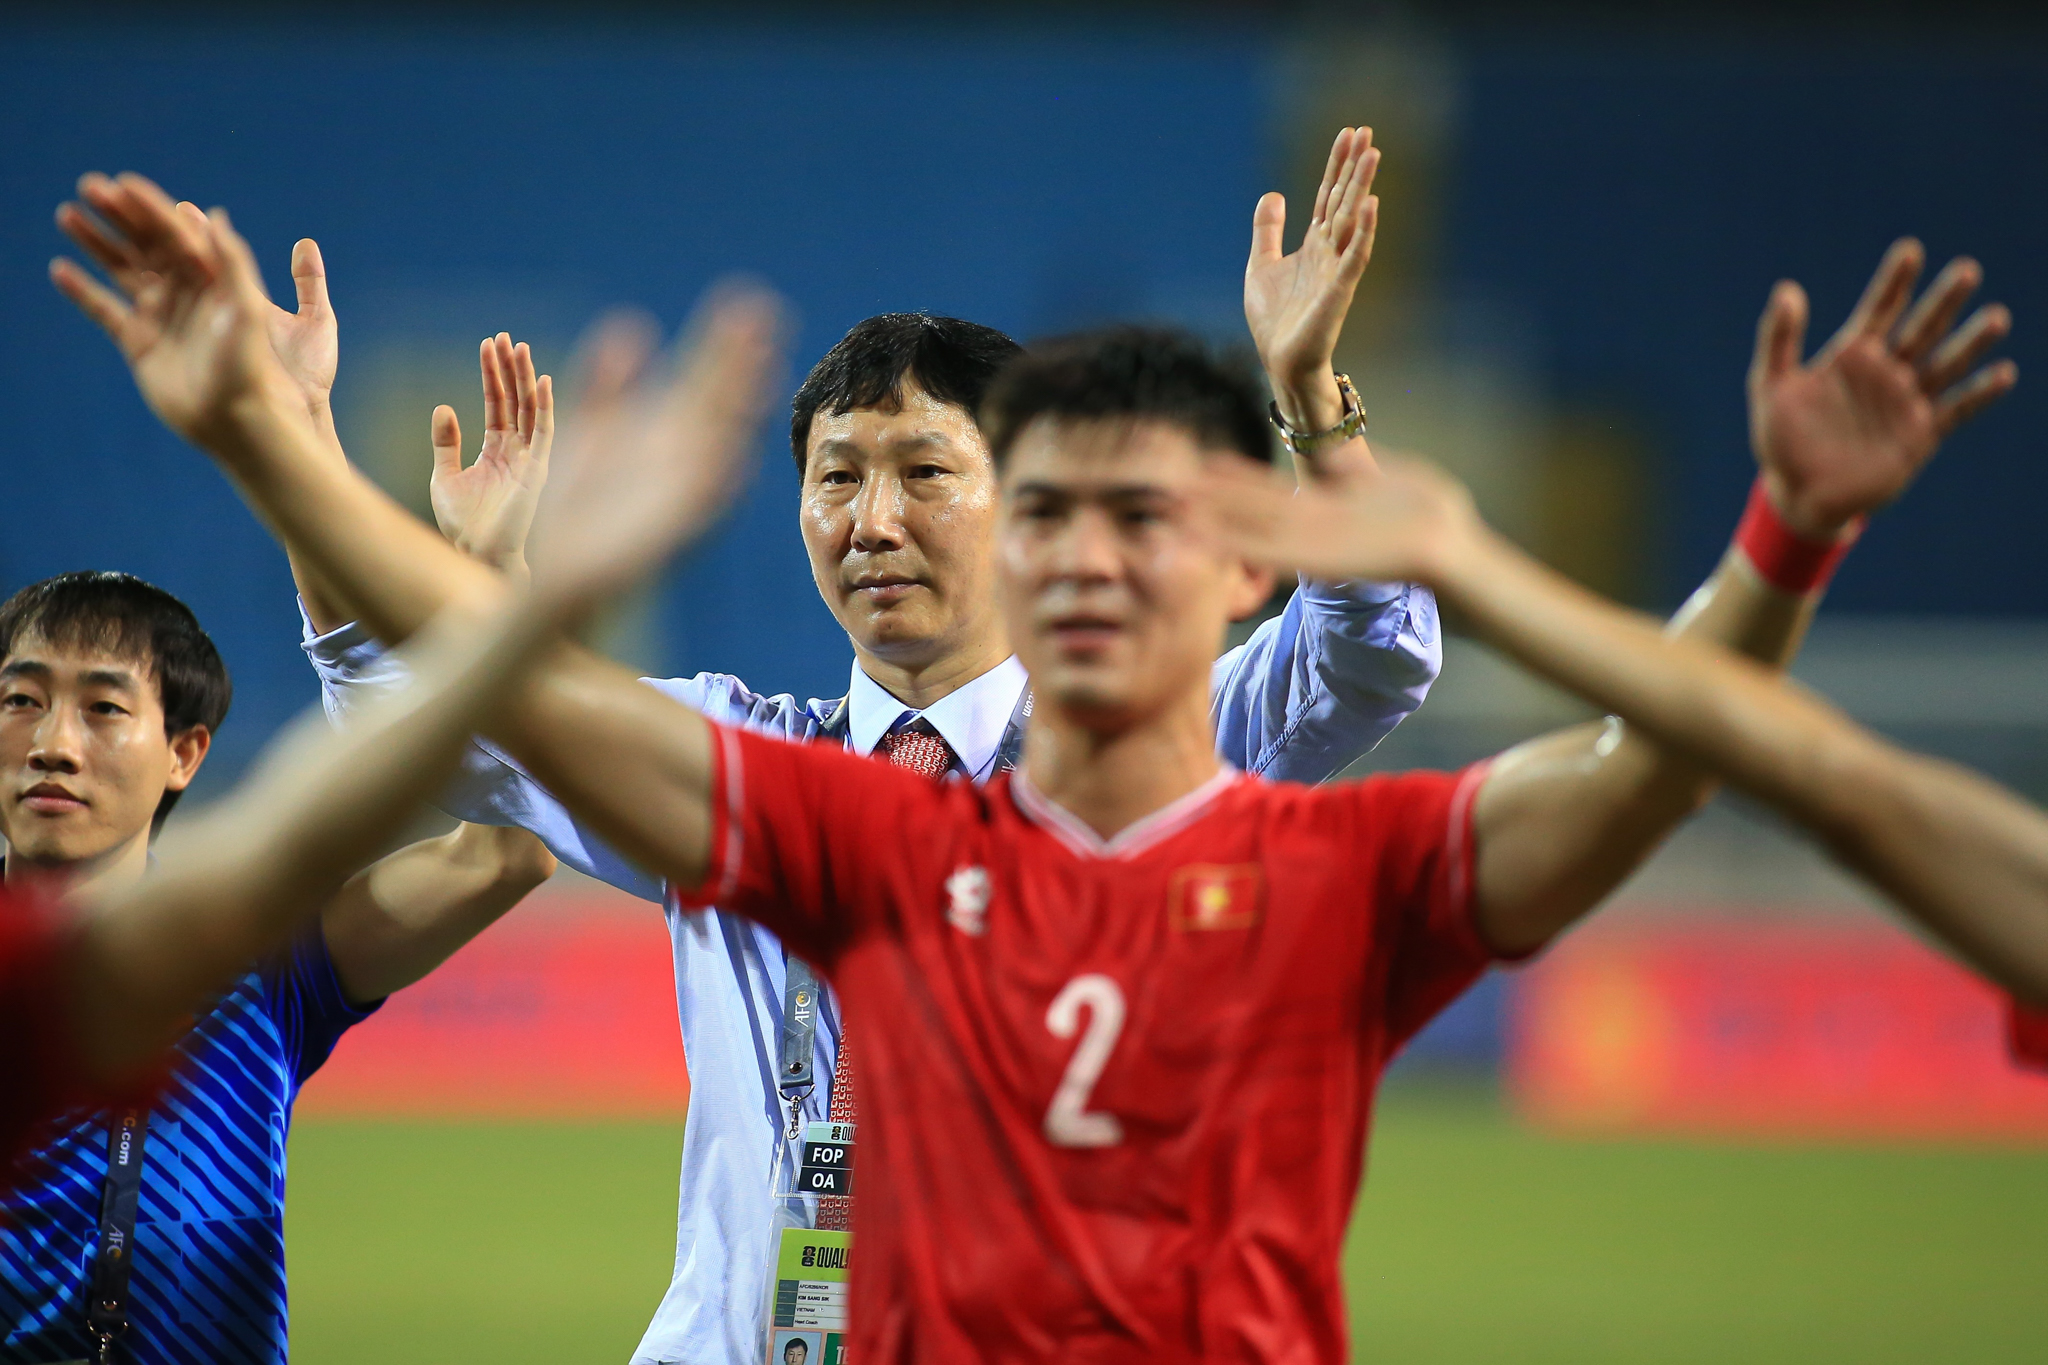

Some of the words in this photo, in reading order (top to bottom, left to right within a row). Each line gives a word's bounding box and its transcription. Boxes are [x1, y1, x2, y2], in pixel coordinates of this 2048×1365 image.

[1044, 972, 1127, 1148] 2
[812, 1147, 843, 1163] FOP
[812, 1173, 835, 1189] OA
